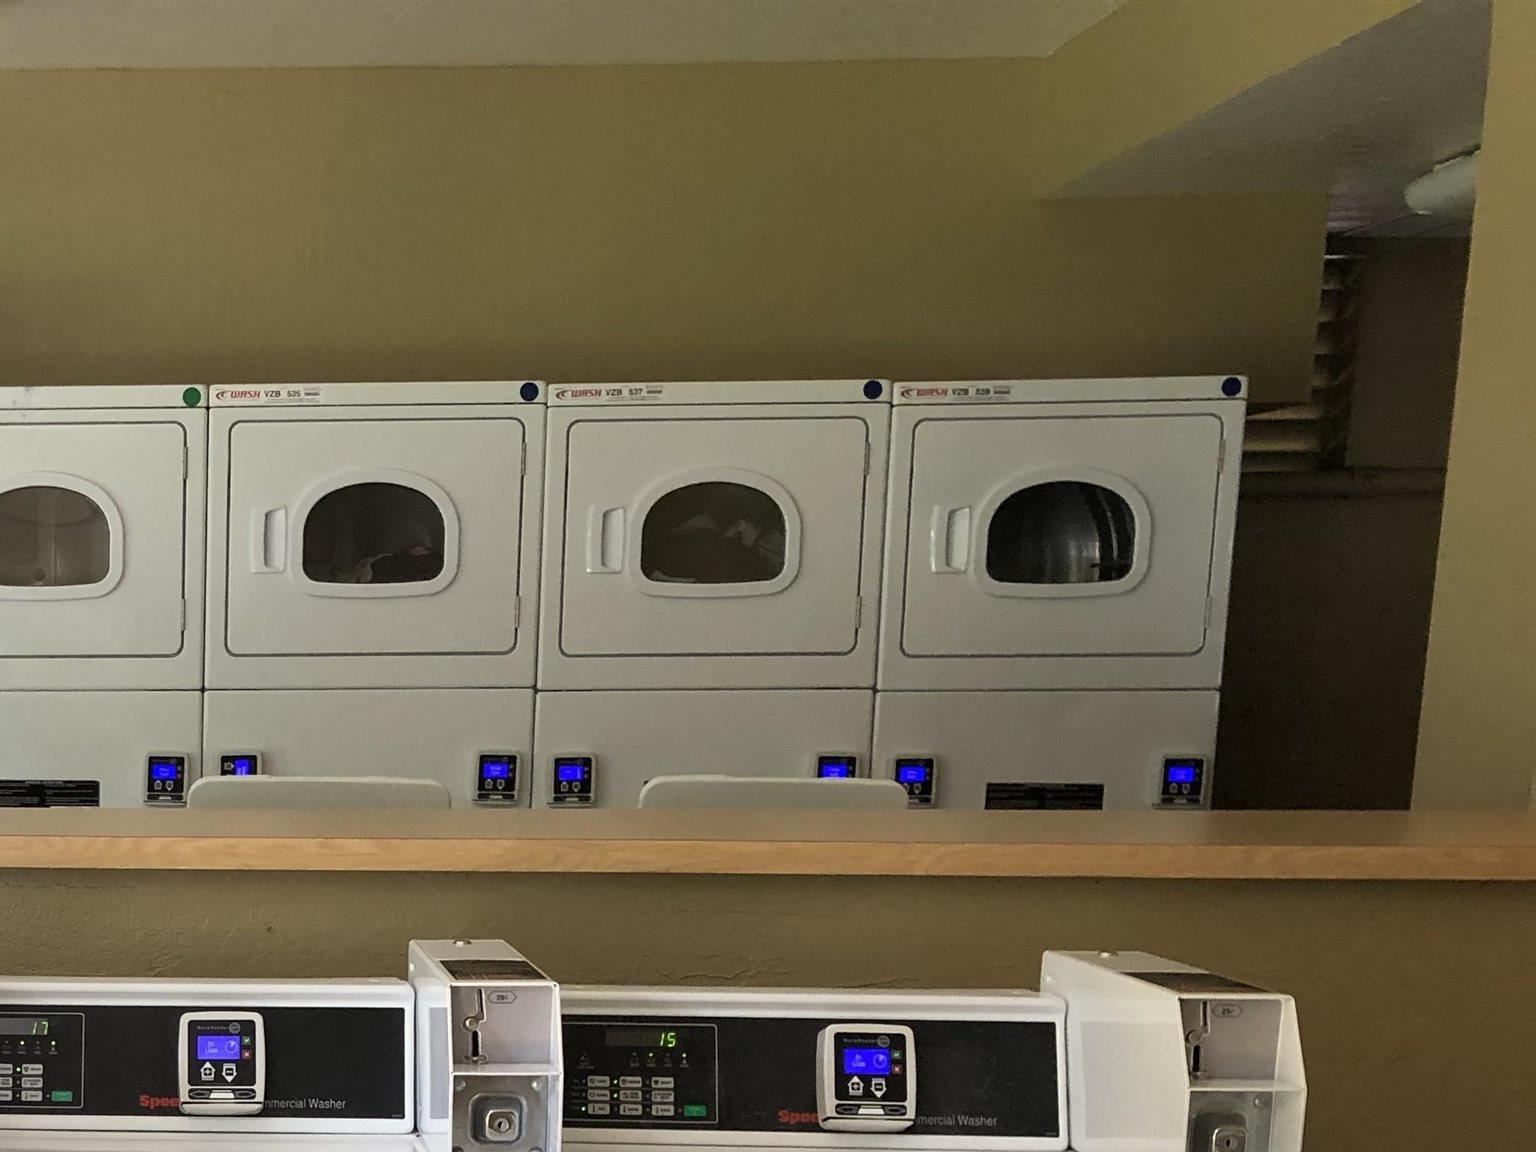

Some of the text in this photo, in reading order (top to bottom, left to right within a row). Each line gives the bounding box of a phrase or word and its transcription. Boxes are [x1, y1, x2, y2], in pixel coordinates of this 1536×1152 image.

[230, 390, 261, 399] WASH
[264, 390, 281, 398] VZB
[570, 389, 602, 398] WASH
[32, 1021, 49, 1035] 17
[660, 1032, 676, 1048] 15
[139, 1094, 346, 1109] Spee mmercial Washer
[778, 1110, 818, 1124] Spee
[957, 1114, 998, 1126] Washer
